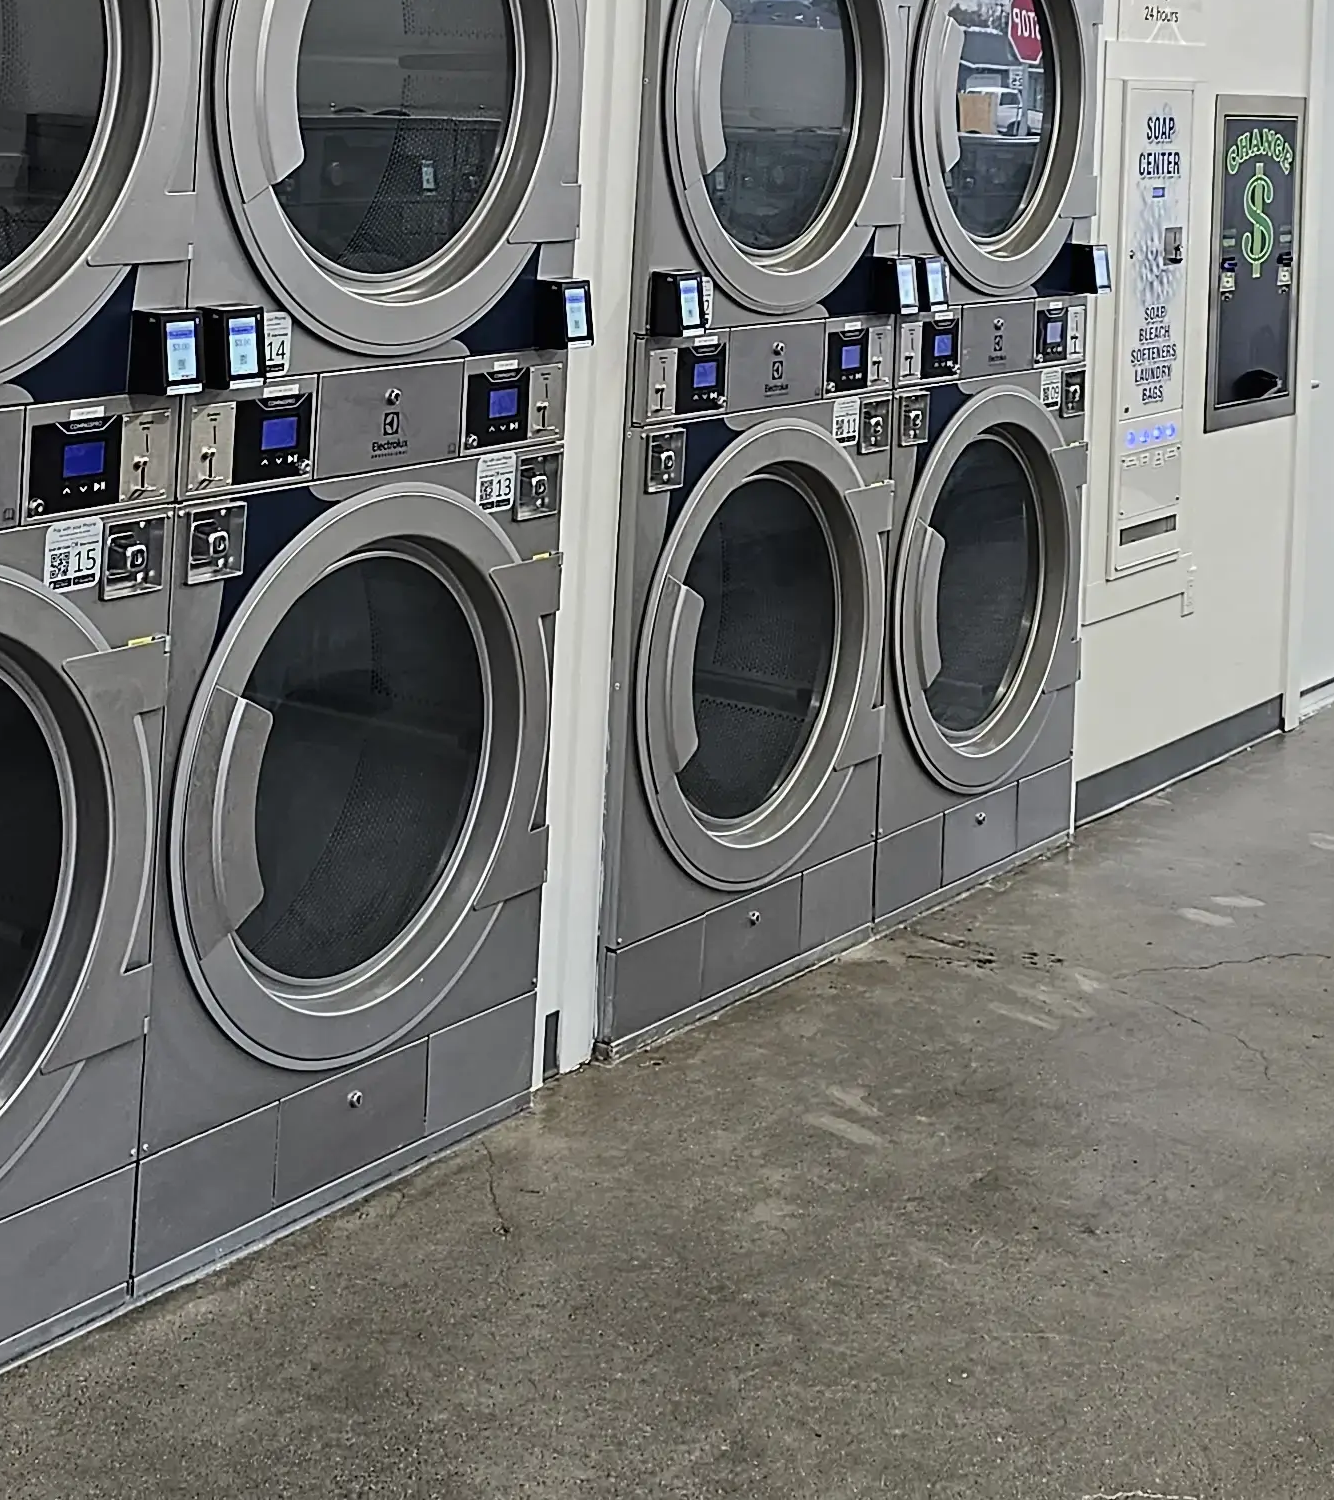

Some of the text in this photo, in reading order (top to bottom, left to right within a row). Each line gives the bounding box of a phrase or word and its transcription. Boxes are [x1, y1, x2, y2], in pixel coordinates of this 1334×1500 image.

[1144, 6, 1179, 23] 24 hours
[1146, 116, 1176, 141] SOAP
[1226, 128, 1293, 175] CHANGE
[1138, 152, 1181, 176] CENTER
[1144, 305, 1166, 321] SOAP
[1139, 325, 1170, 342] BLEACH
[266, 339, 286, 362] 14
[1131, 344, 1177, 363] SOFTENERS
[1135, 364, 1172, 383] LAUNDRY
[1142, 385, 1163, 401] BAGS
[372, 438, 409, 453] Electrolux
[495, 477, 512, 498] 13
[74, 547, 97, 573] 15
